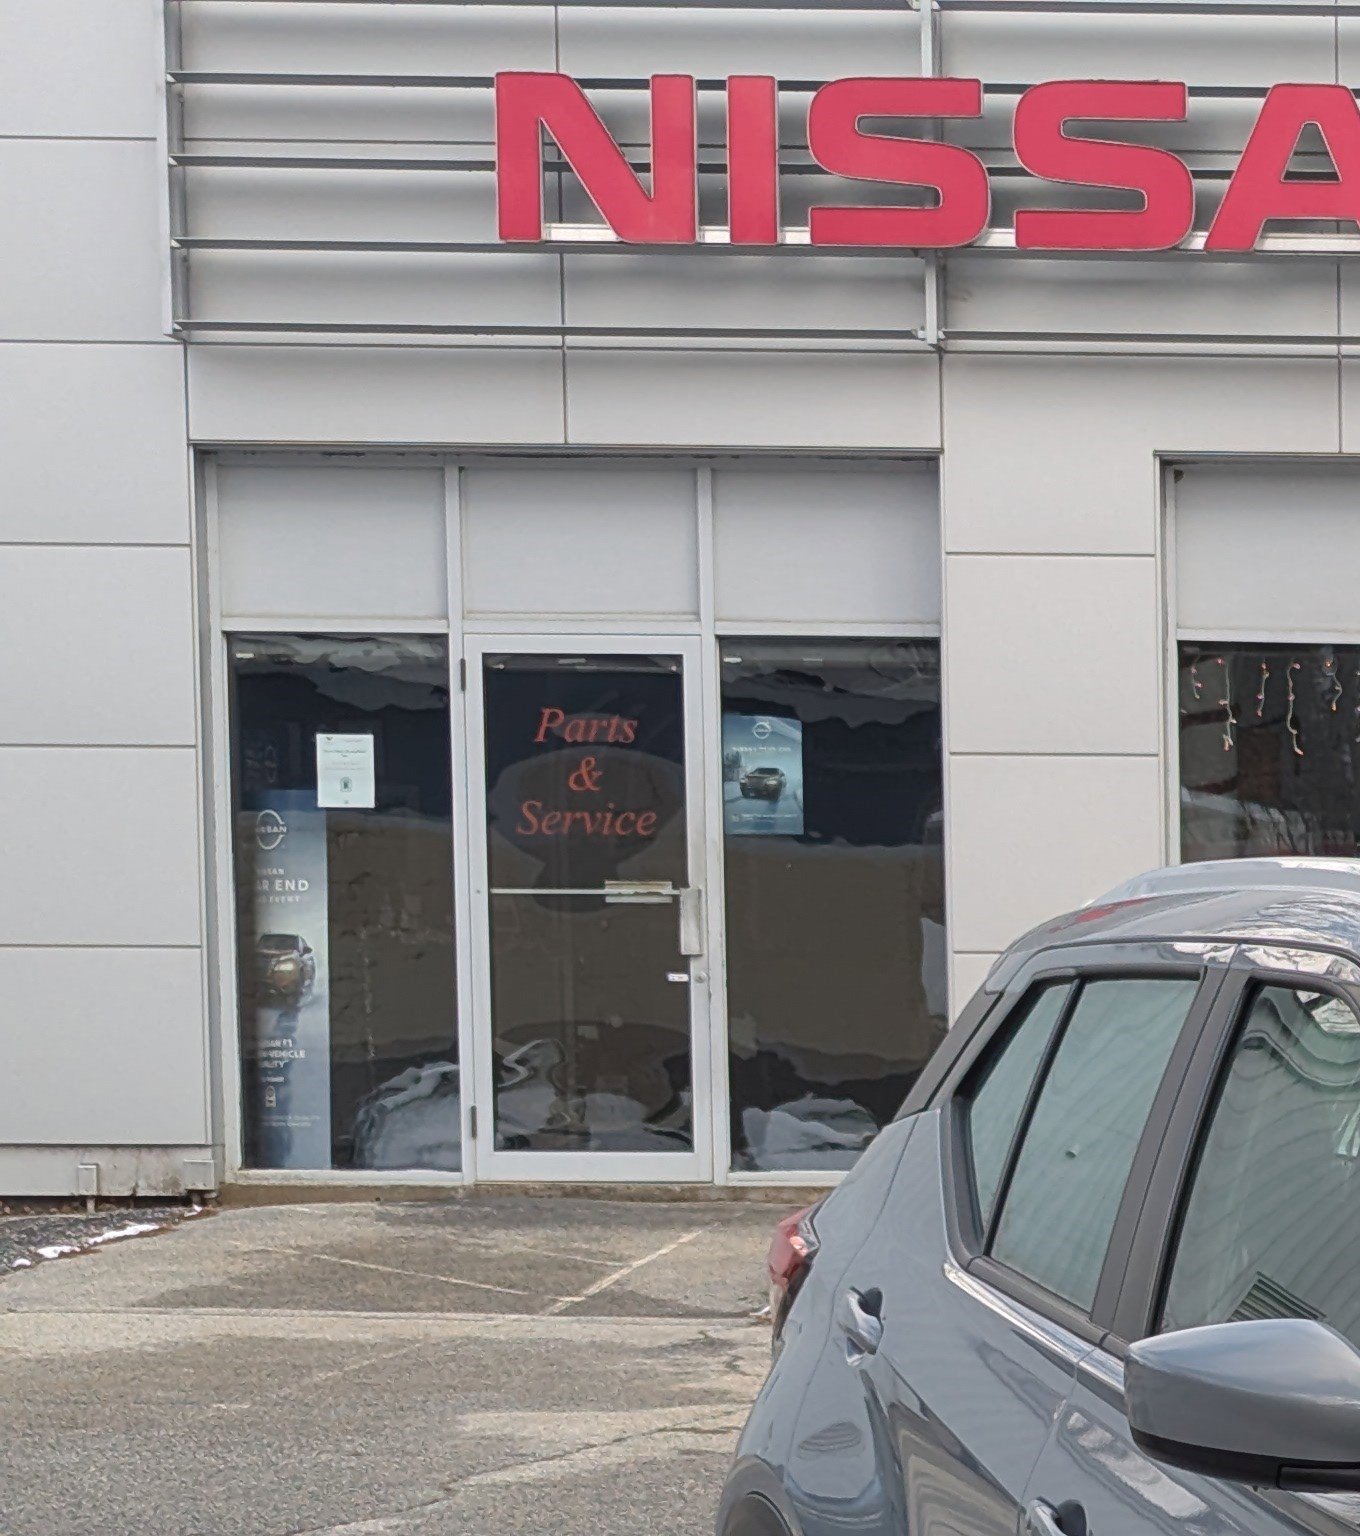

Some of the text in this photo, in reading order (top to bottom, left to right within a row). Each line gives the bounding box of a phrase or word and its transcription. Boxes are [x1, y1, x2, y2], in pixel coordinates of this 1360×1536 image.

[533, 707, 638, 743] Parts
[568, 756, 603, 791] &
[516, 800, 657, 836] Service
[275, 879, 309, 892] END
